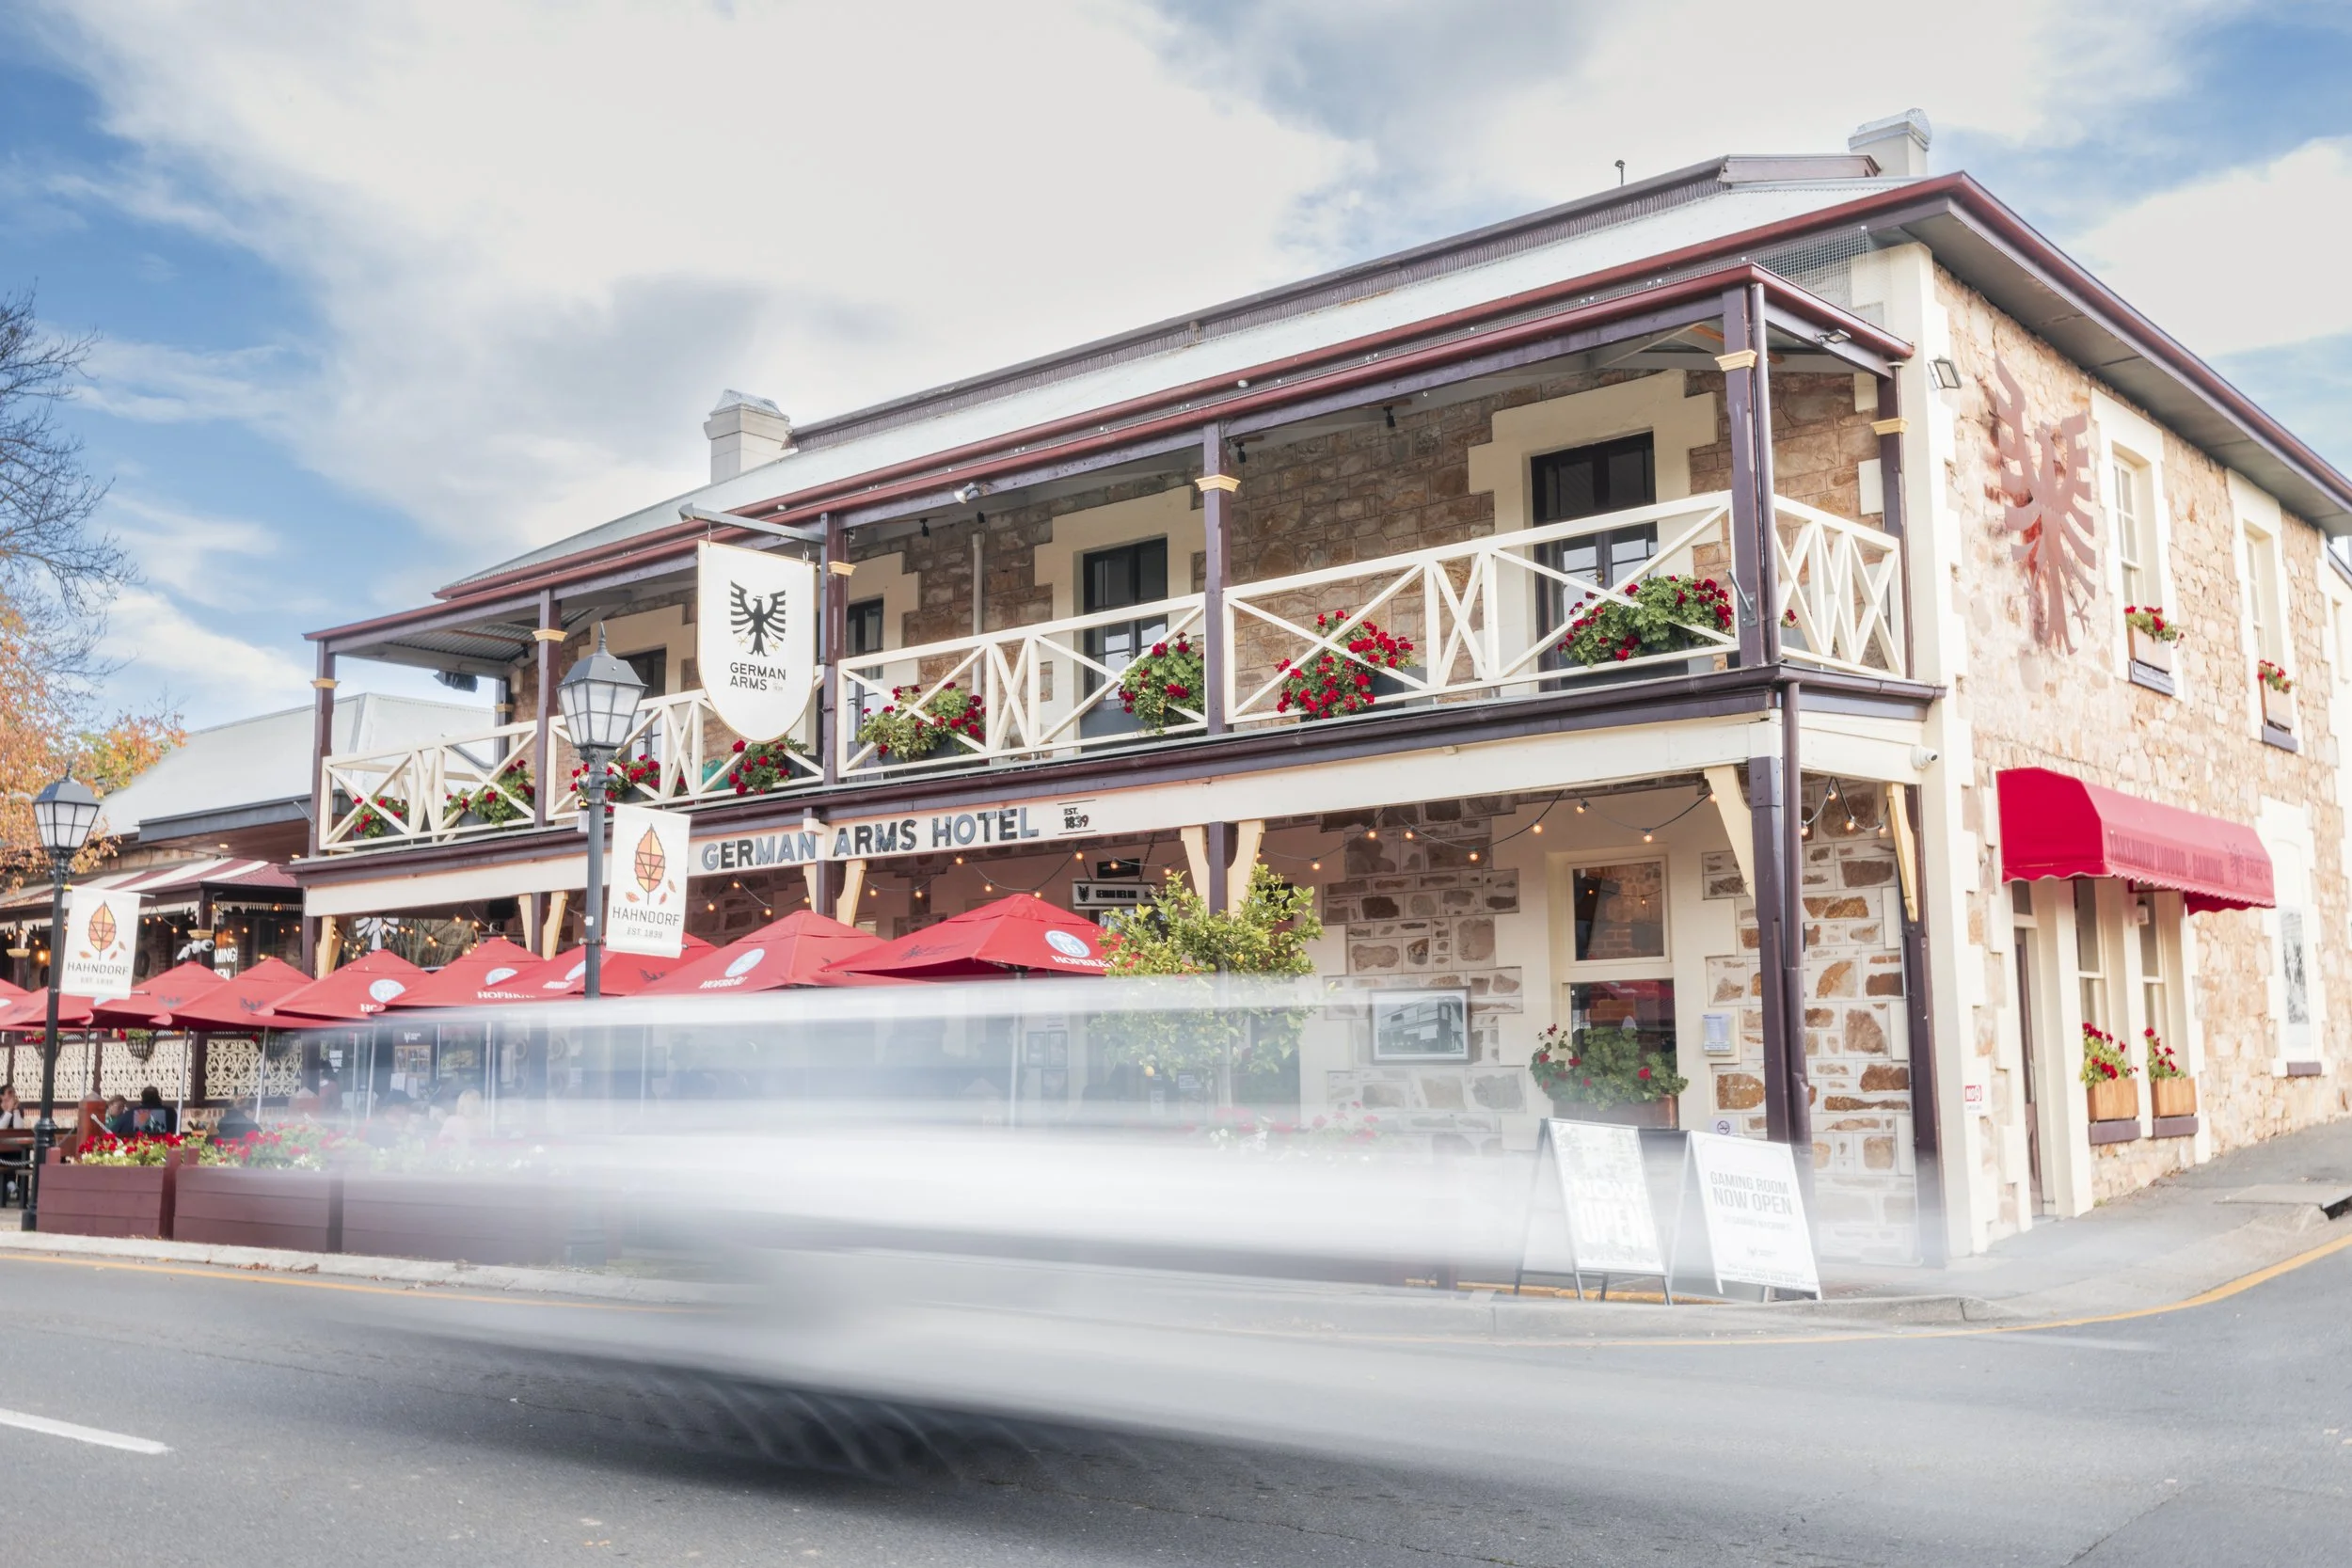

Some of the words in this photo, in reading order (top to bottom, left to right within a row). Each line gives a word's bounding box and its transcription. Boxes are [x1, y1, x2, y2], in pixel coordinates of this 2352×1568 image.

[730, 662, 787, 680] GERMAN
[730, 675, 768, 690] ARMS
[1064, 816, 1089, 829] 1839
[701, 832, 816, 871] GERMAN
[833, 819, 916, 857] ARMS
[932, 807, 1039, 847] HOTEL
[612, 906, 680, 926] HAHNDORF
[215, 947, 236, 962] MING
[68, 961, 129, 975] HAHNDORF
[1710, 1171, 1753, 1190] GAMING
[1756, 1178, 1789, 1195] ROOM
[1712, 1187, 1747, 1210] NOW
[1753, 1194, 1793, 1215] OPEN
[1578, 1200, 1651, 1247] OPEN
